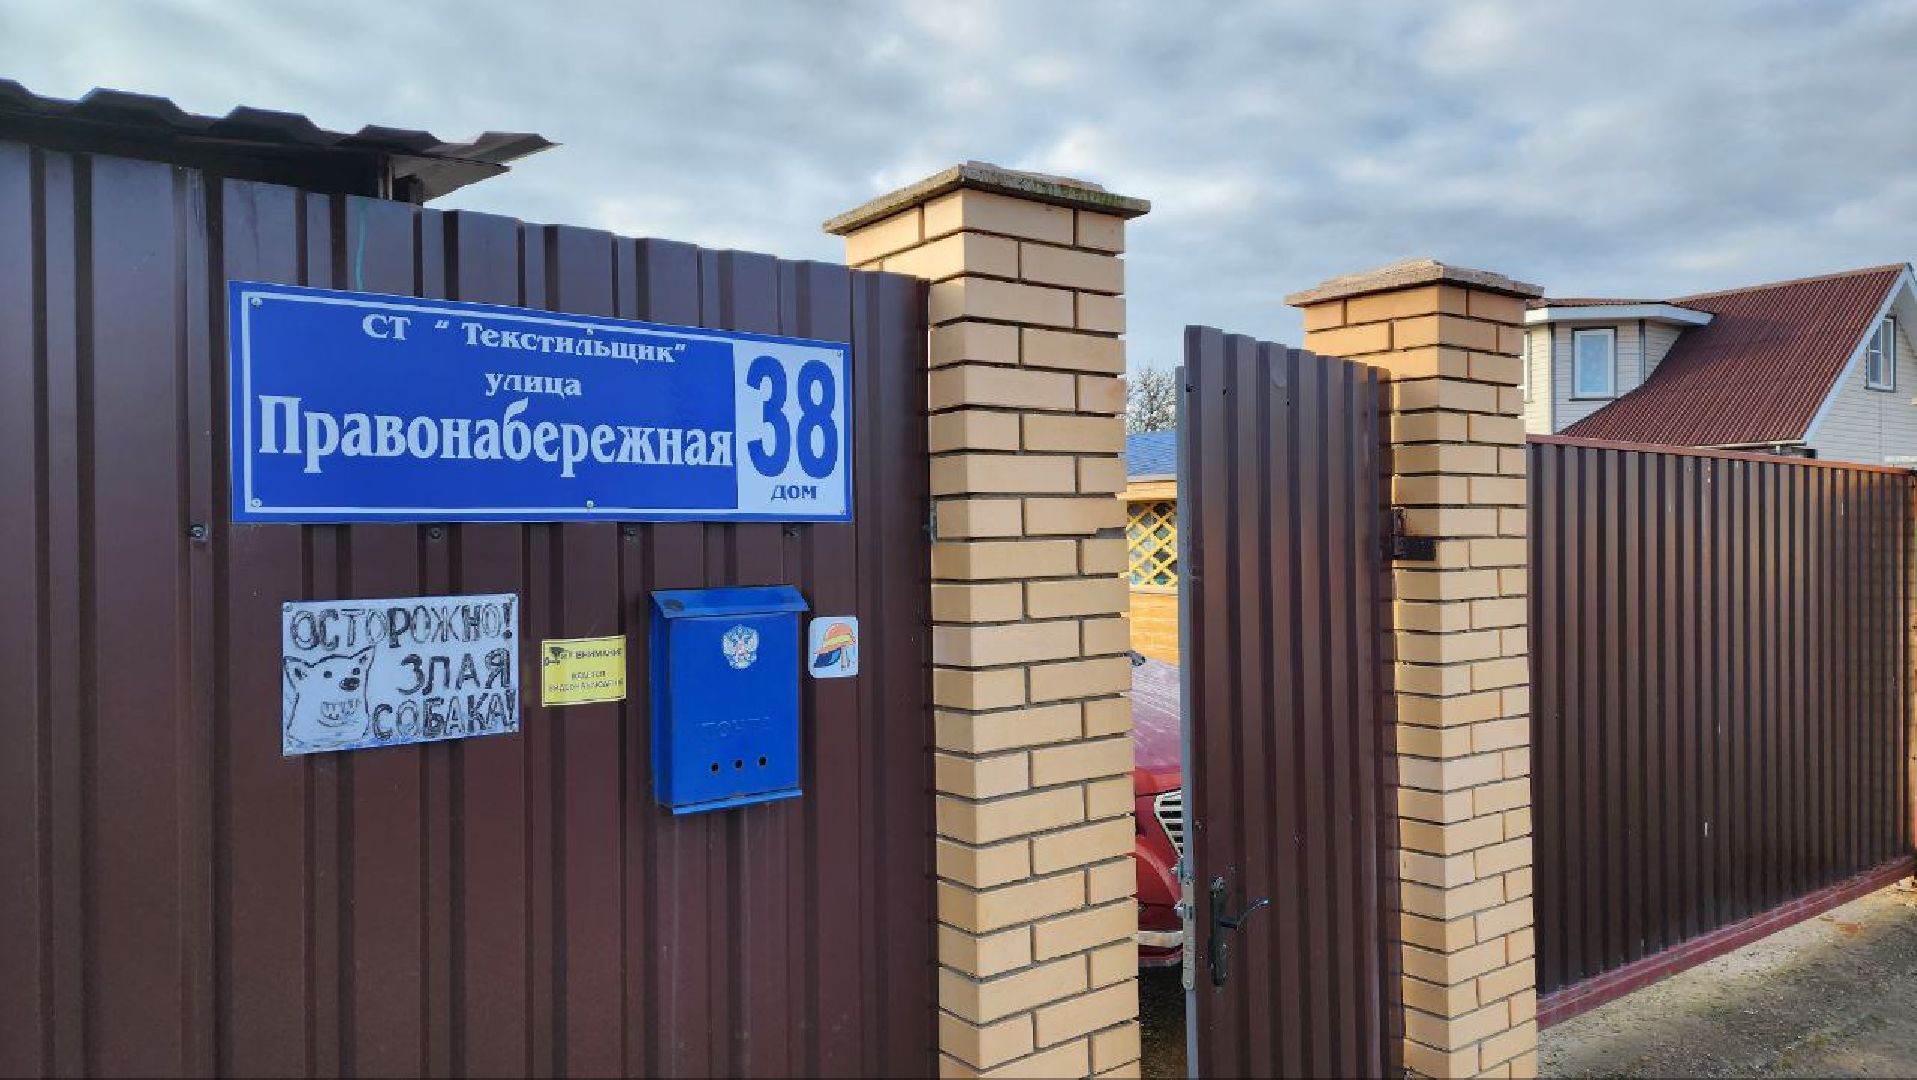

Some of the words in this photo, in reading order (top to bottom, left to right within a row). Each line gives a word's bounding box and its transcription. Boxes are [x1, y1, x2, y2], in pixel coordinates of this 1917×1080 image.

[362, 314, 411, 341] СТ
[485, 372, 582, 398] улица
[258, 395, 733, 478] Правонабережная
[747, 355, 838, 479] 38
[770, 485, 817, 502] дом
[290, 603, 513, 650] ОСТОРОЖНО!
[398, 648, 511, 695] ЗЛАЯ
[371, 689, 516, 740] СОБАКА!
